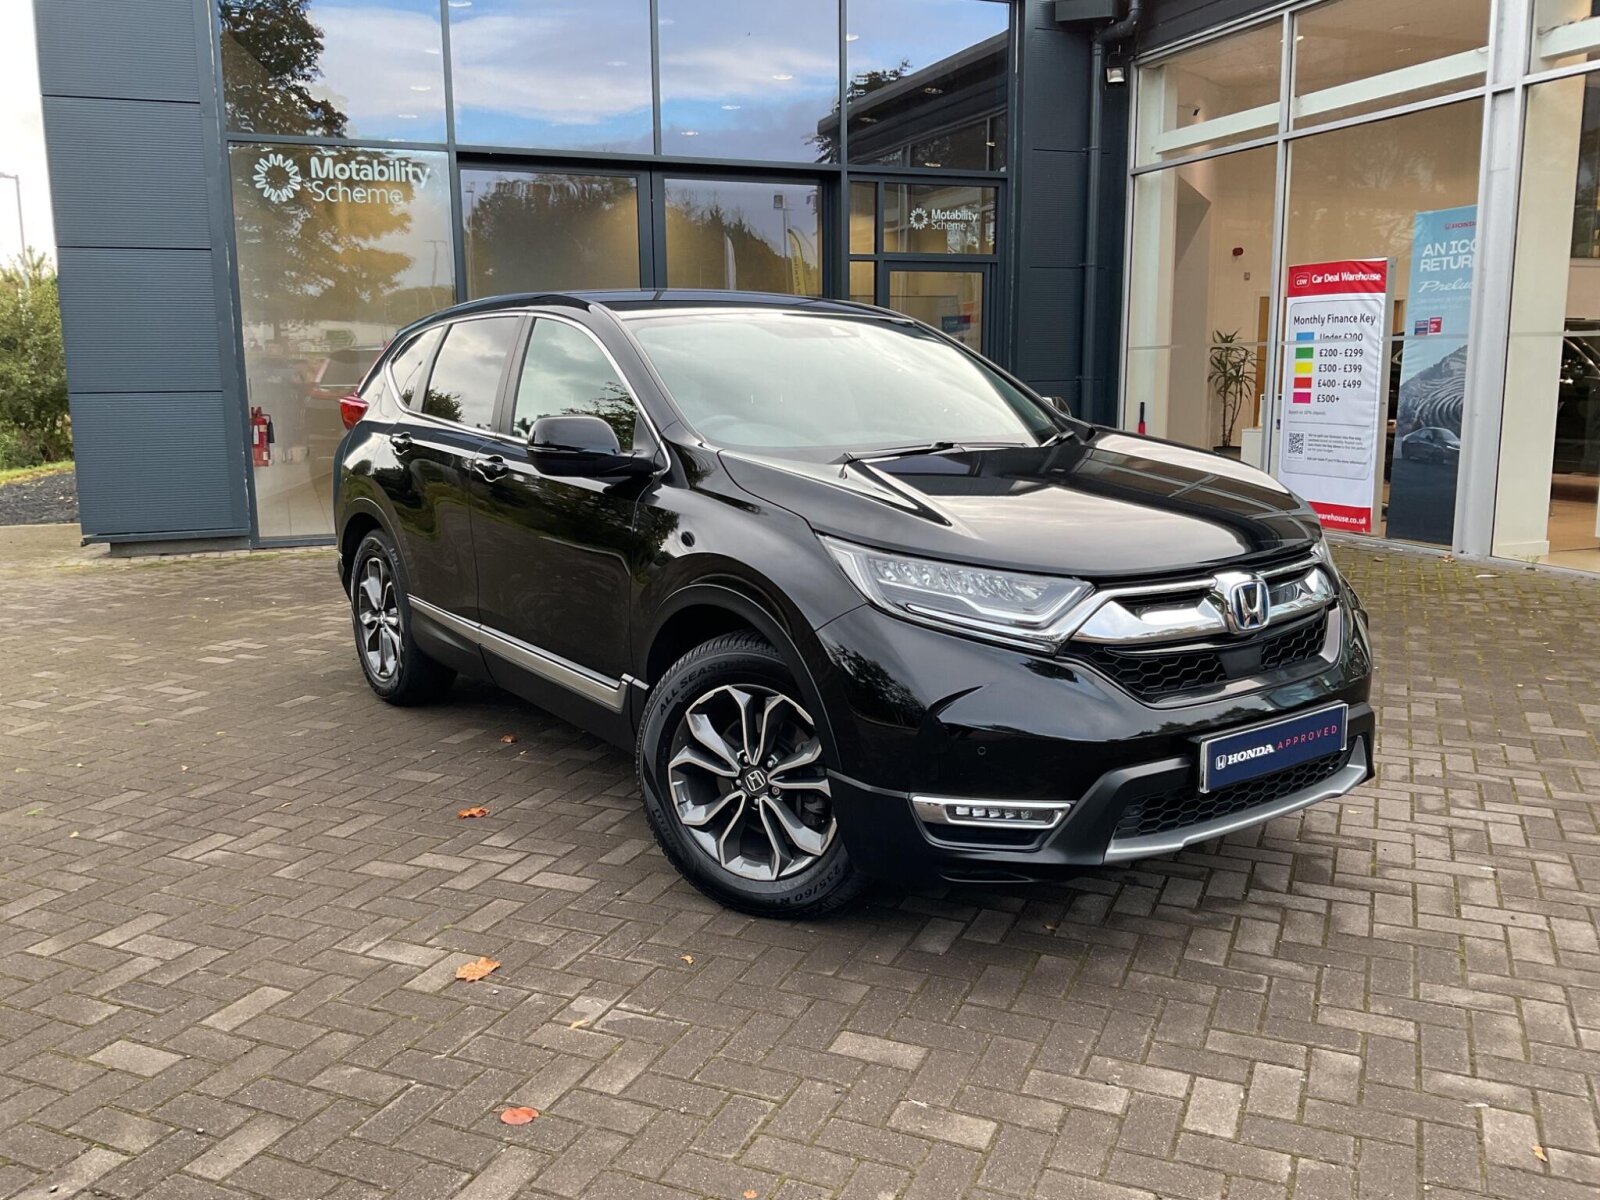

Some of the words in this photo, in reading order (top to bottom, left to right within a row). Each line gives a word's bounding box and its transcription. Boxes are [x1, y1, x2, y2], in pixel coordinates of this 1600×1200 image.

[310, 156, 431, 189] Motability
[311, 180, 404, 205] Scheme
[931, 208, 978, 223] Motability
[931, 220, 967, 231] Scheme
[1422, 242, 1447, 257] AN
[1311, 274, 1323, 284] Car
[1324, 272, 1340, 282] Deal
[1341, 272, 1382, 282] Warehouse
[1293, 314, 1326, 326] Monthly
[1327, 313, 1358, 324] Finance
[1360, 313, 1376, 326] Key
[1320, 332, 1342, 341] Under
[1319, 348, 1338, 357] £200
[1344, 348, 1364, 357] £299
[1318, 364, 1337, 373] £300
[1343, 364, 1363, 373] £399
[1317, 379, 1336, 388] £400
[1342, 379, 1362, 388] £499
[1316, 394, 1340, 403] £500+
[659, 688, 680, 716] ALL
[1227, 744, 1276, 765] HONDA
[1277, 725, 1338, 751] APPROVED
